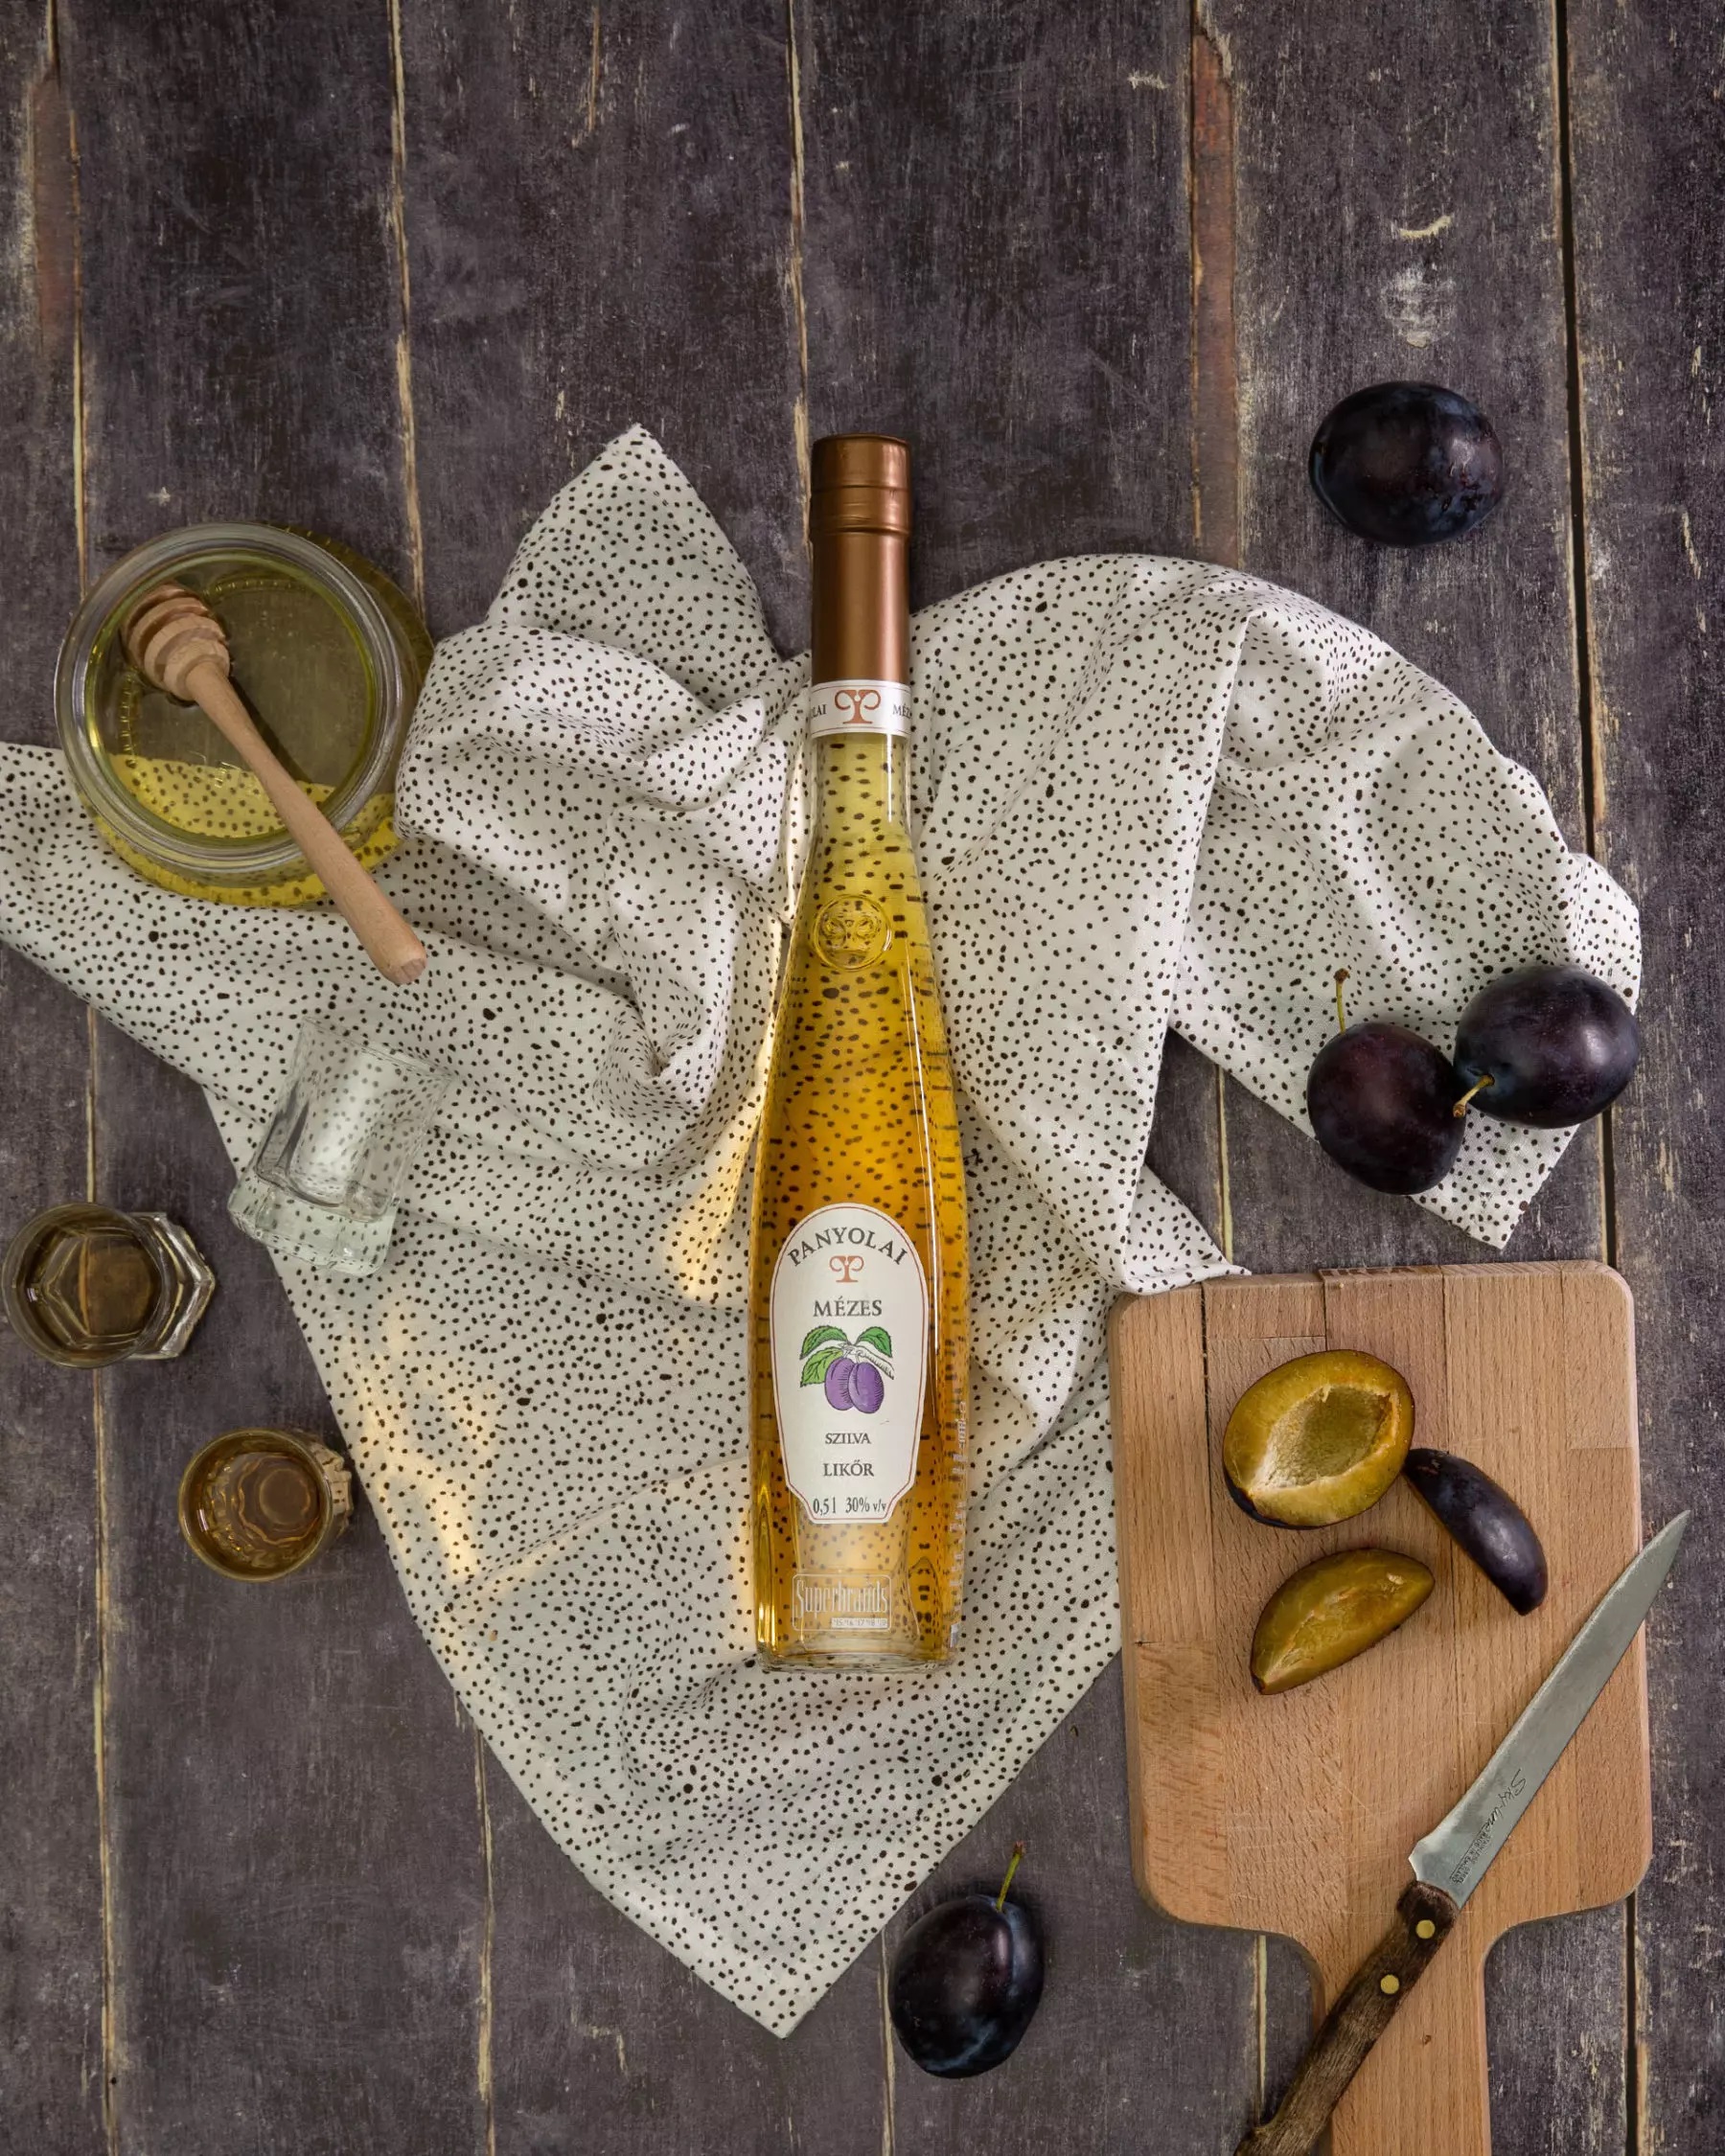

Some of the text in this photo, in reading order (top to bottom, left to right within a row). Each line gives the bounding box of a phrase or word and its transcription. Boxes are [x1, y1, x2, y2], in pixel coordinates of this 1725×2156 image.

[788, 1227, 908, 1267] PANYOLAI
[813, 1296, 883, 1317] MÉZES
[825, 1433, 871, 1444] SZILVA
[822, 1459, 875, 1478] LIKŐR
[813, 1498, 830, 1516] 0,5
[845, 1496, 870, 1514] 30%
[873, 1498, 887, 1513] v/v
[796, 1579, 888, 1619] Superbrands
